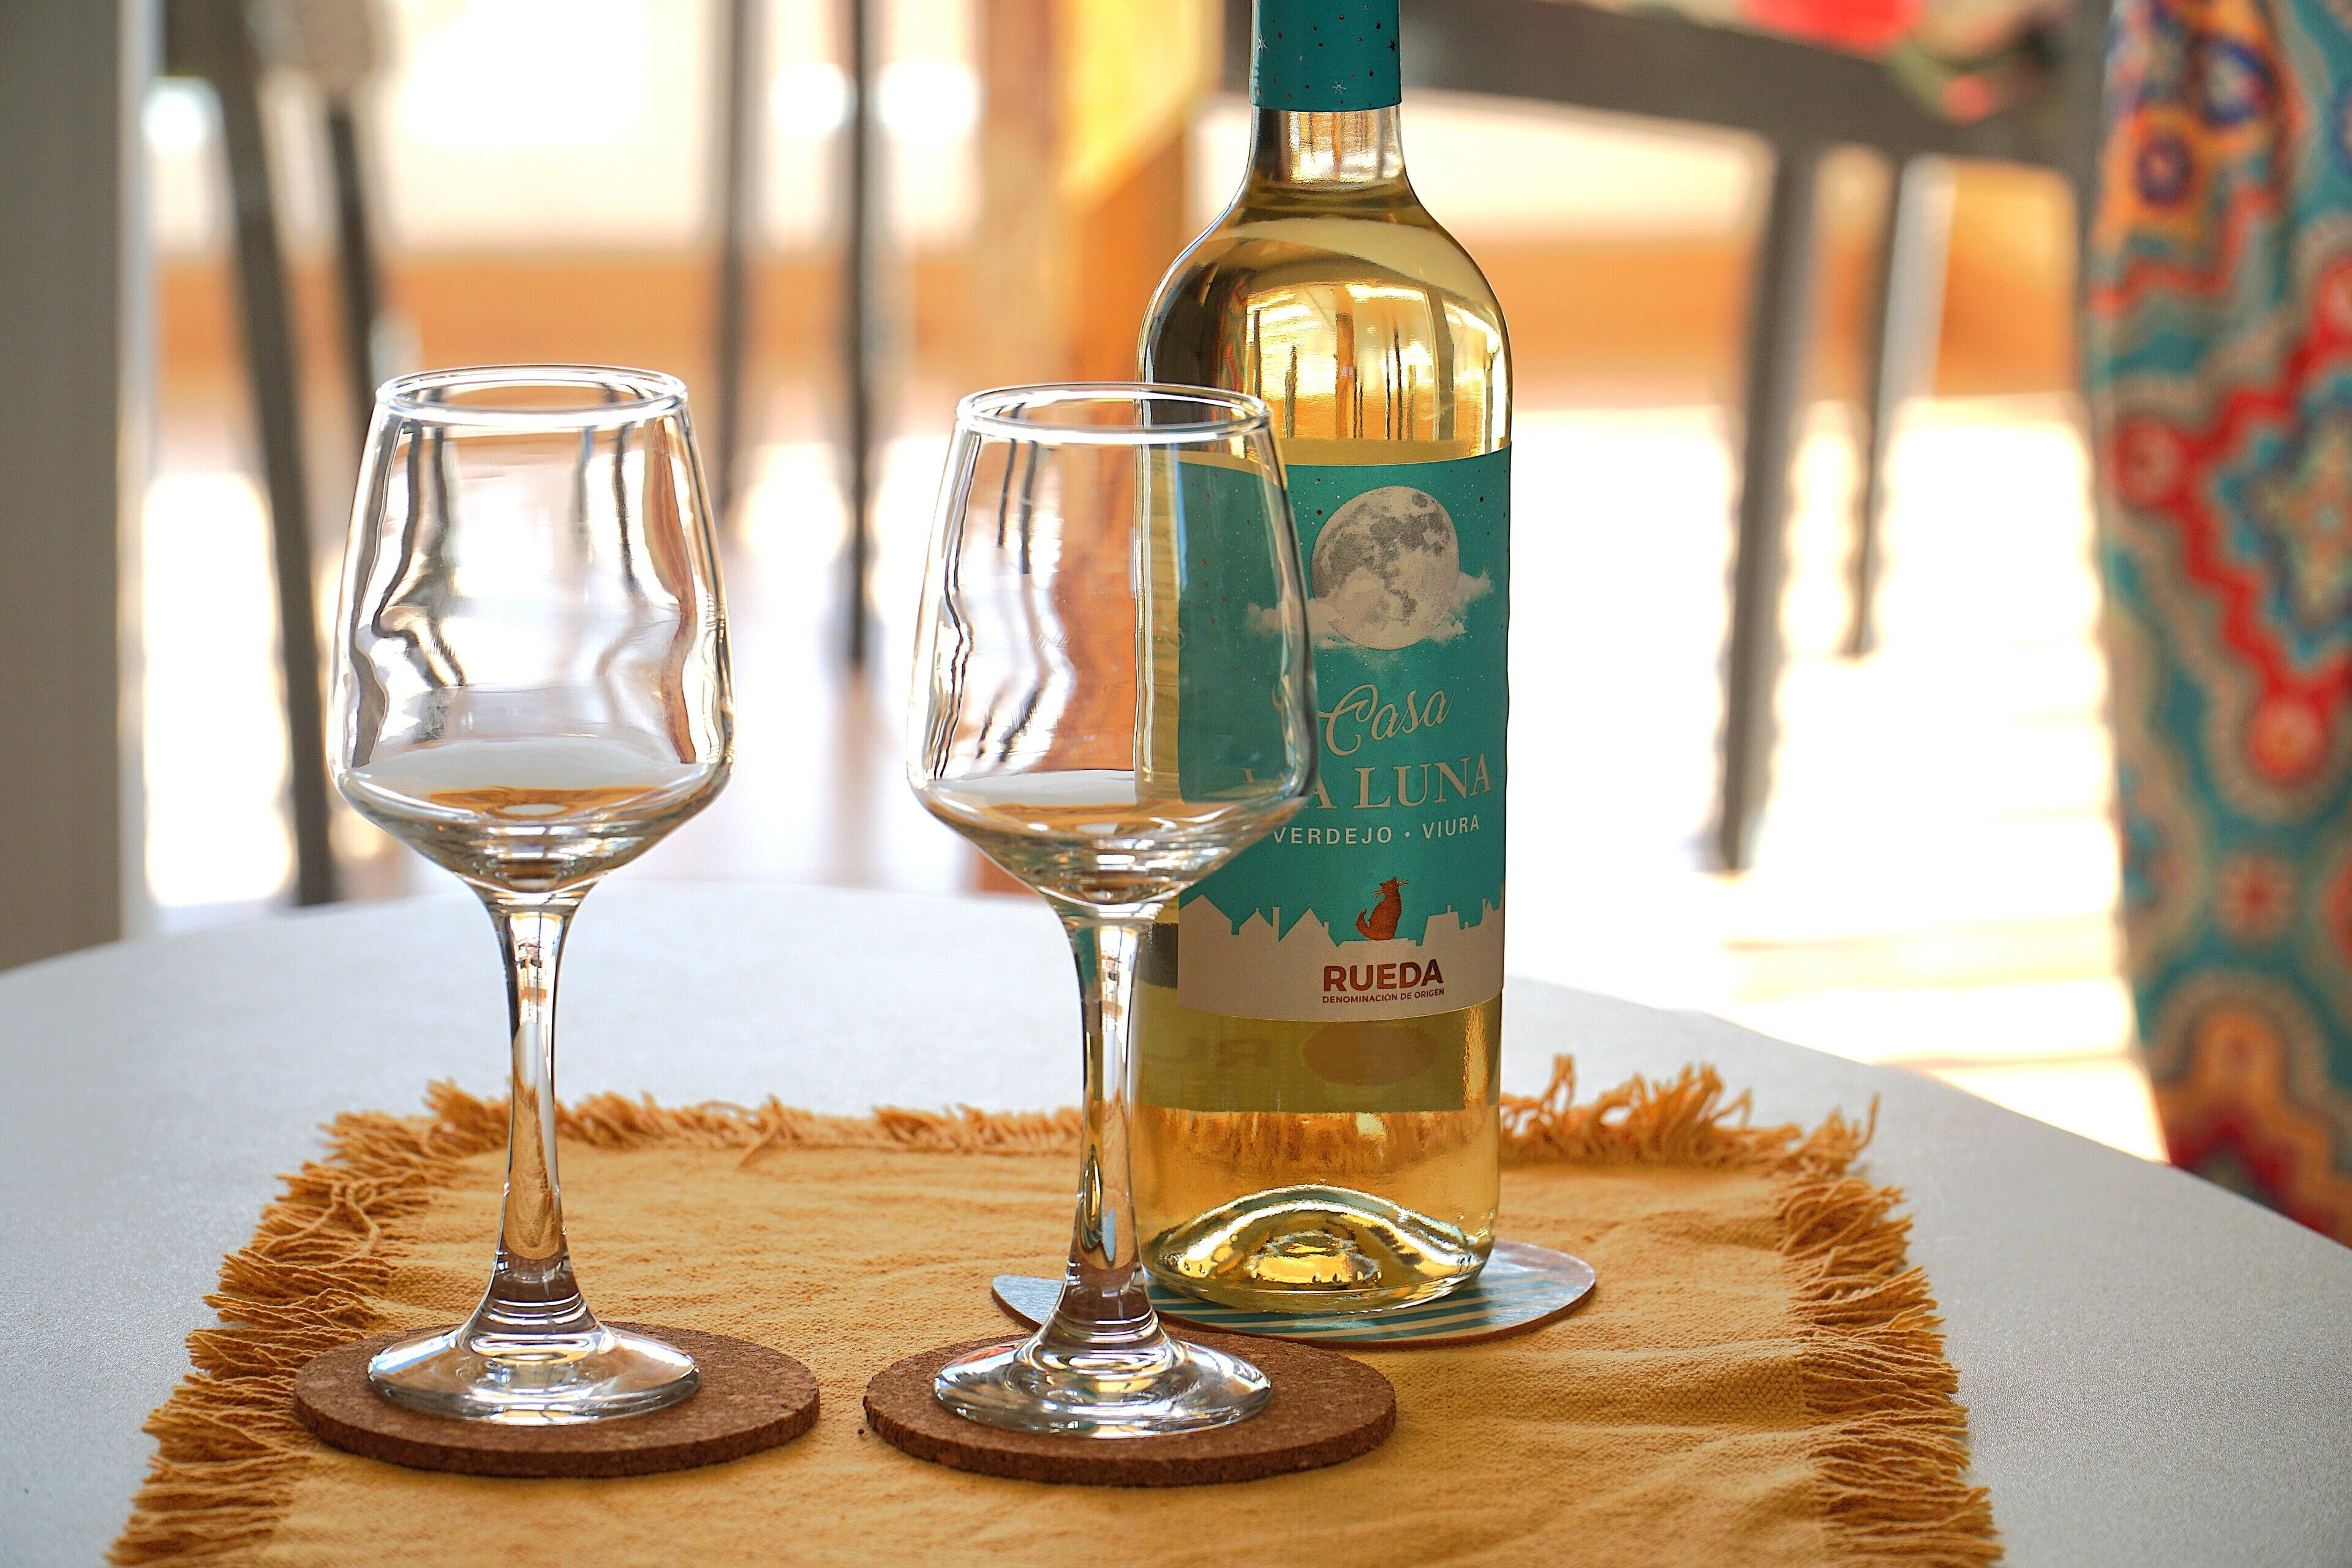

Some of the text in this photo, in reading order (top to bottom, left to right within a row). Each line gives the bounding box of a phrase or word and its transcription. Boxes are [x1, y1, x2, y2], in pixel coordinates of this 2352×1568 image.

[1318, 684, 1456, 756] Casa
[1352, 753, 1492, 809] LUNA
[1274, 814, 1480, 845] VERDEJO VIURA
[1323, 959, 1444, 992] RUEDA
[1322, 987, 1445, 1003] DENOMINACIÓN DE ORIGEN
